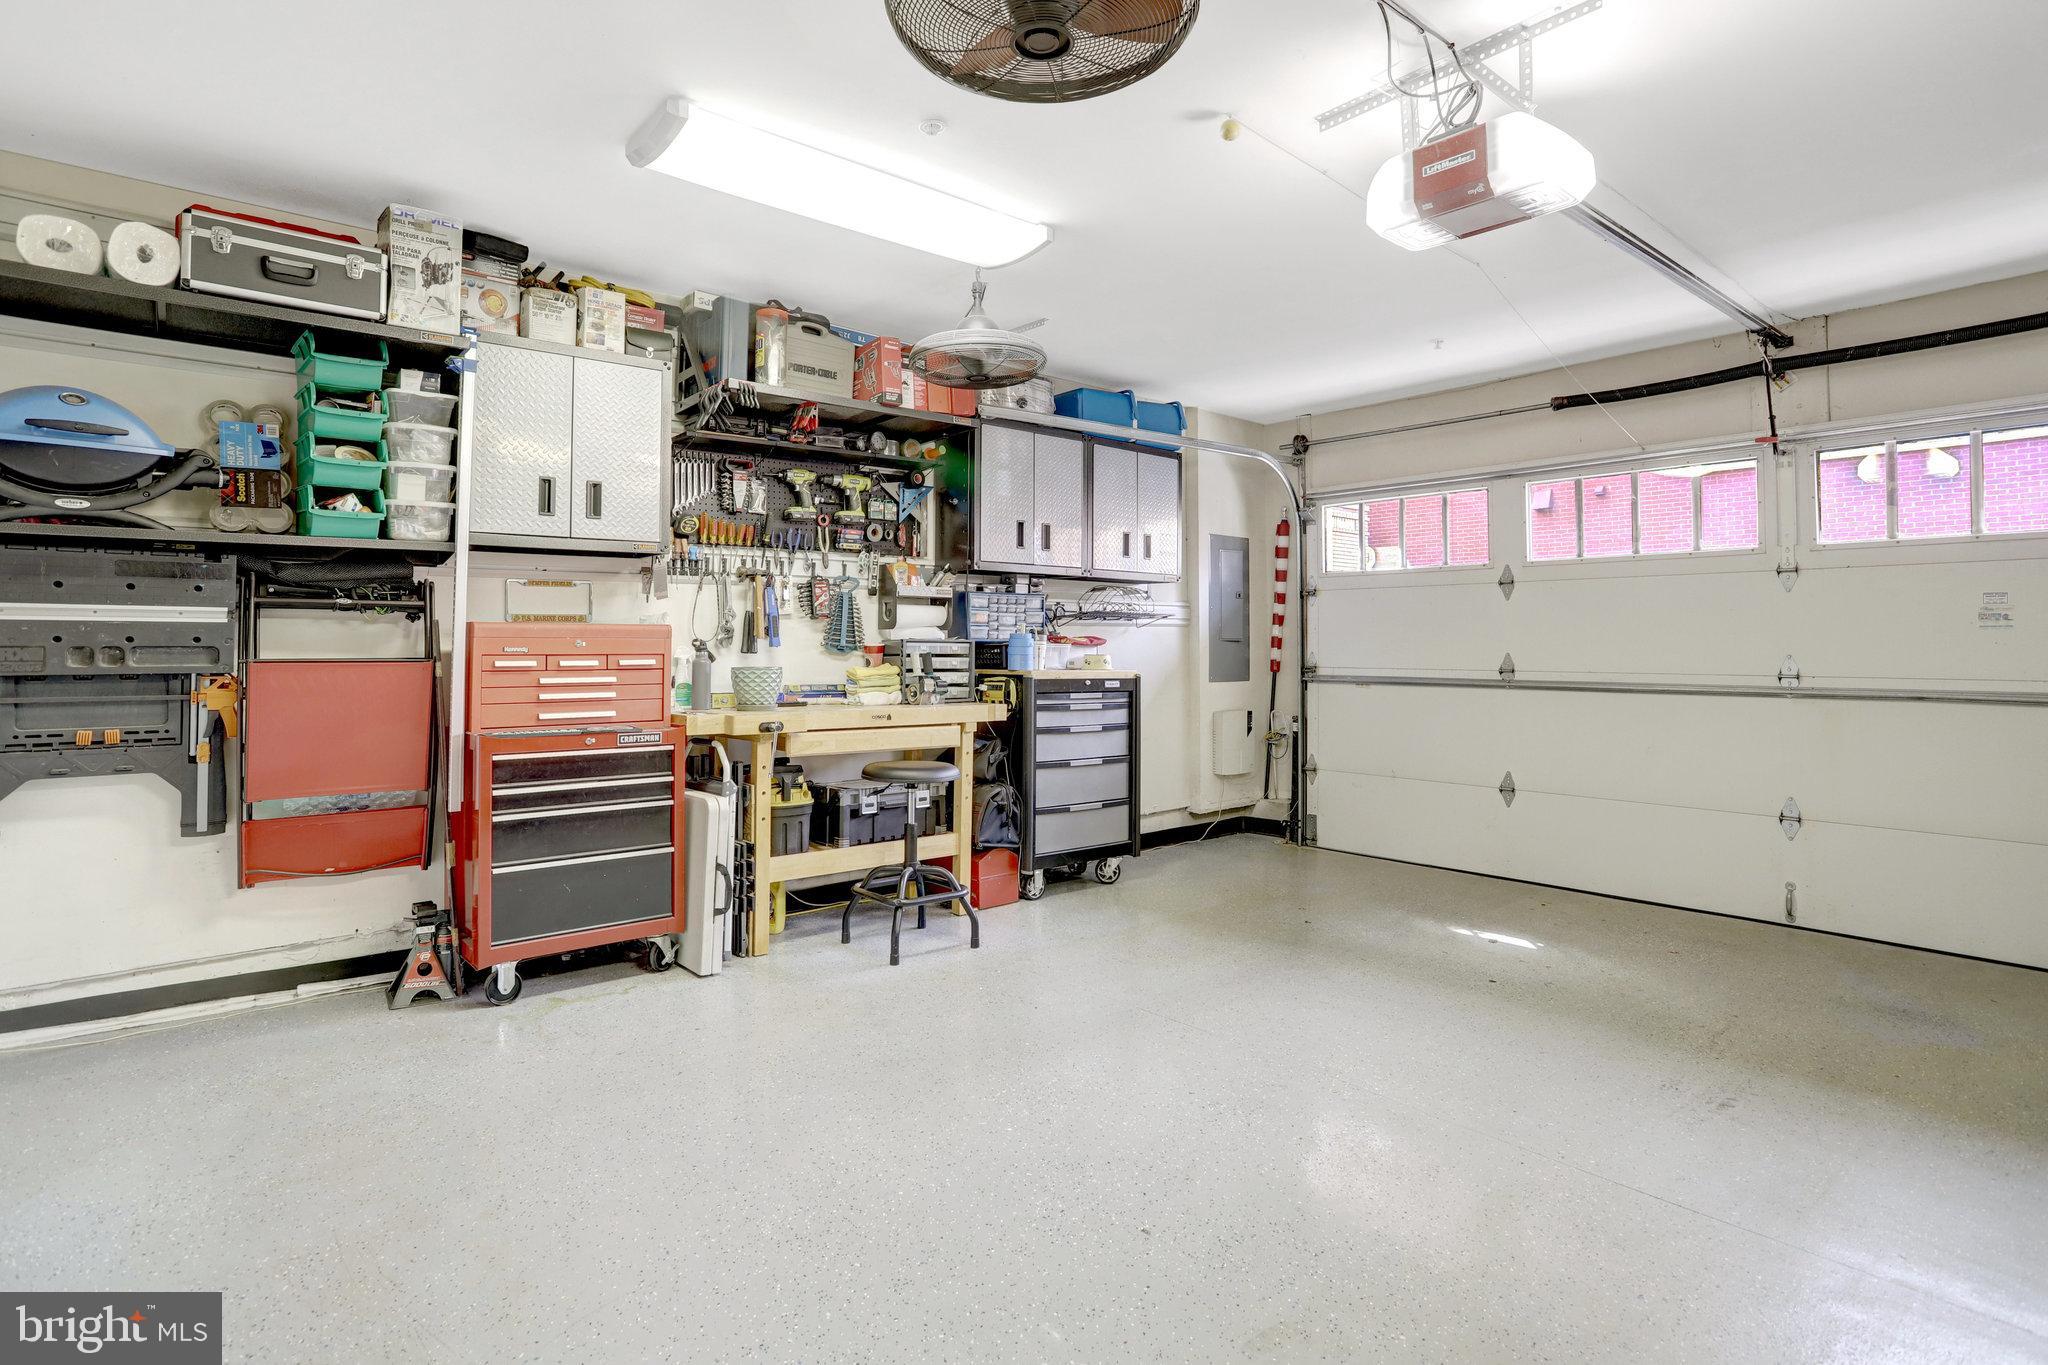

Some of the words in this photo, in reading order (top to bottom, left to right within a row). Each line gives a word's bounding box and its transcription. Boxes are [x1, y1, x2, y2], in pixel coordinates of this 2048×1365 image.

[391, 217, 406, 225] DRILL
[256, 424, 264, 435] 3M
[226, 440, 236, 466] HEAVY
[236, 445, 245, 466] DUTY
[236, 472, 246, 503] Scotch
[620, 735, 660, 743] CRAFTSMAN
